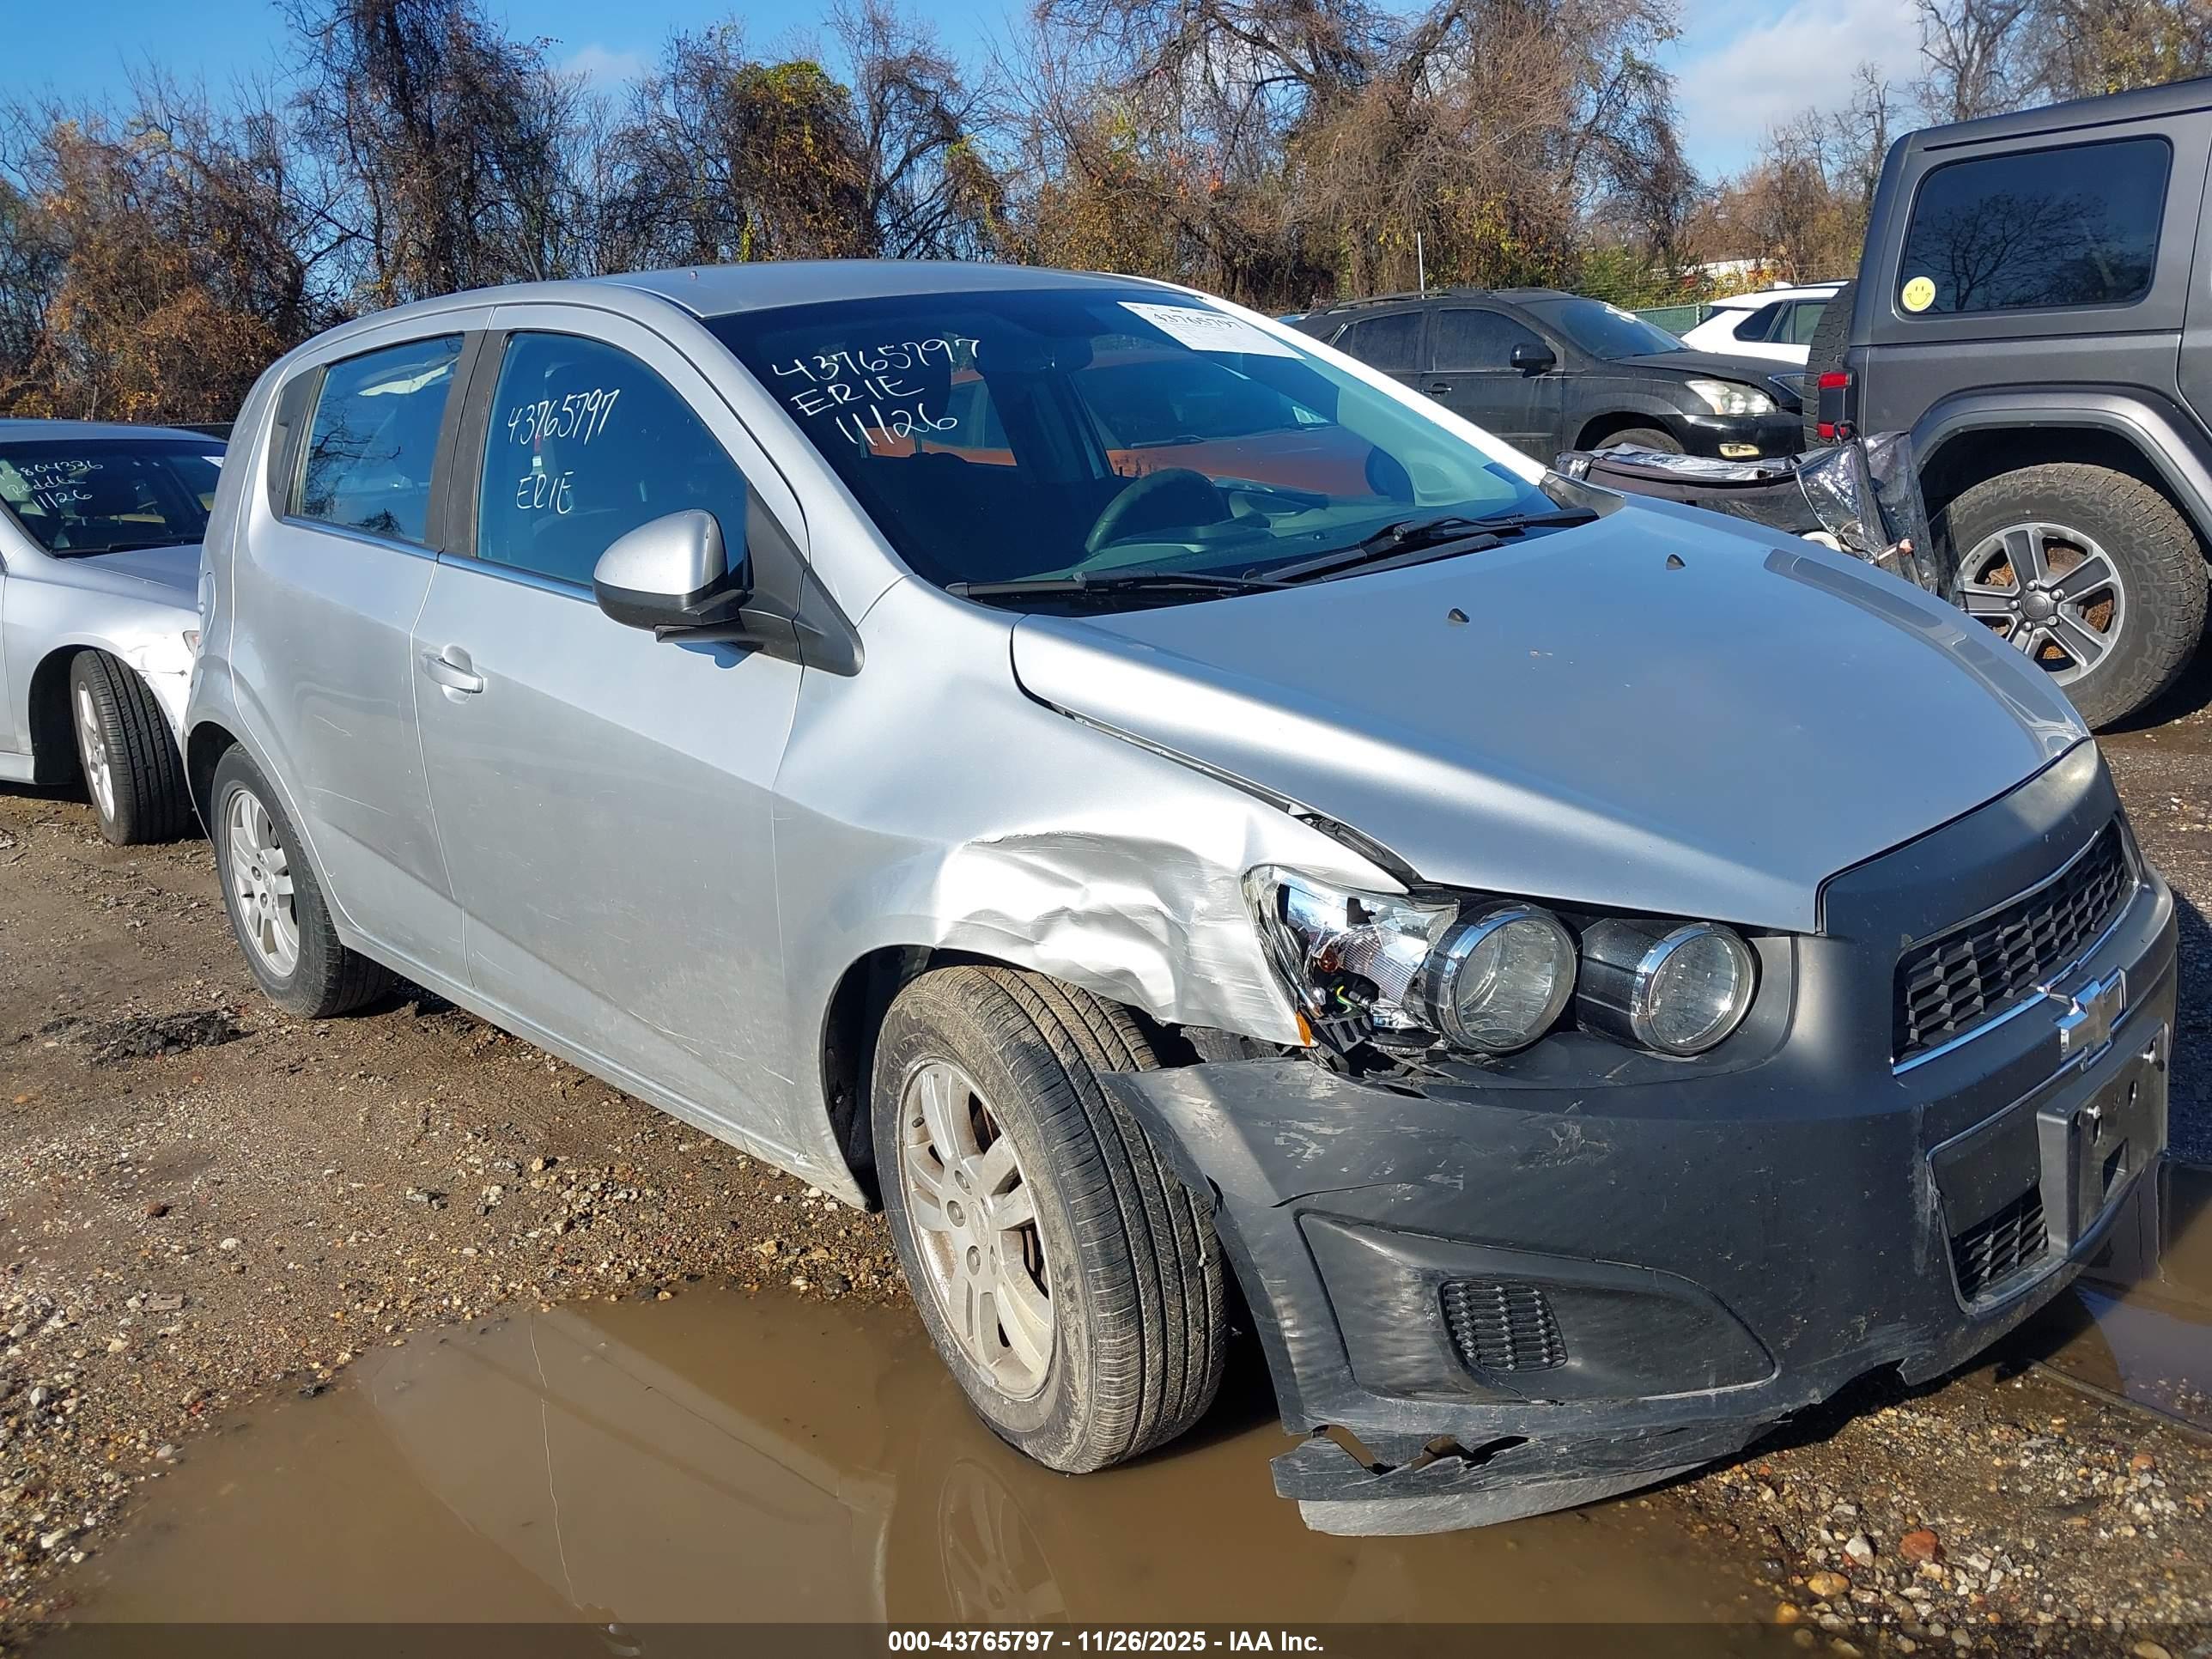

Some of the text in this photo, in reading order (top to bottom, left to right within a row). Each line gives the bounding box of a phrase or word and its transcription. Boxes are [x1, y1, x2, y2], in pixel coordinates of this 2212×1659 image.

[772, 339, 981, 382] 43765797
[507, 388, 621, 447] 43765797
[791, 376, 926, 416] ERIE
[516, 471, 575, 515] ERIE
